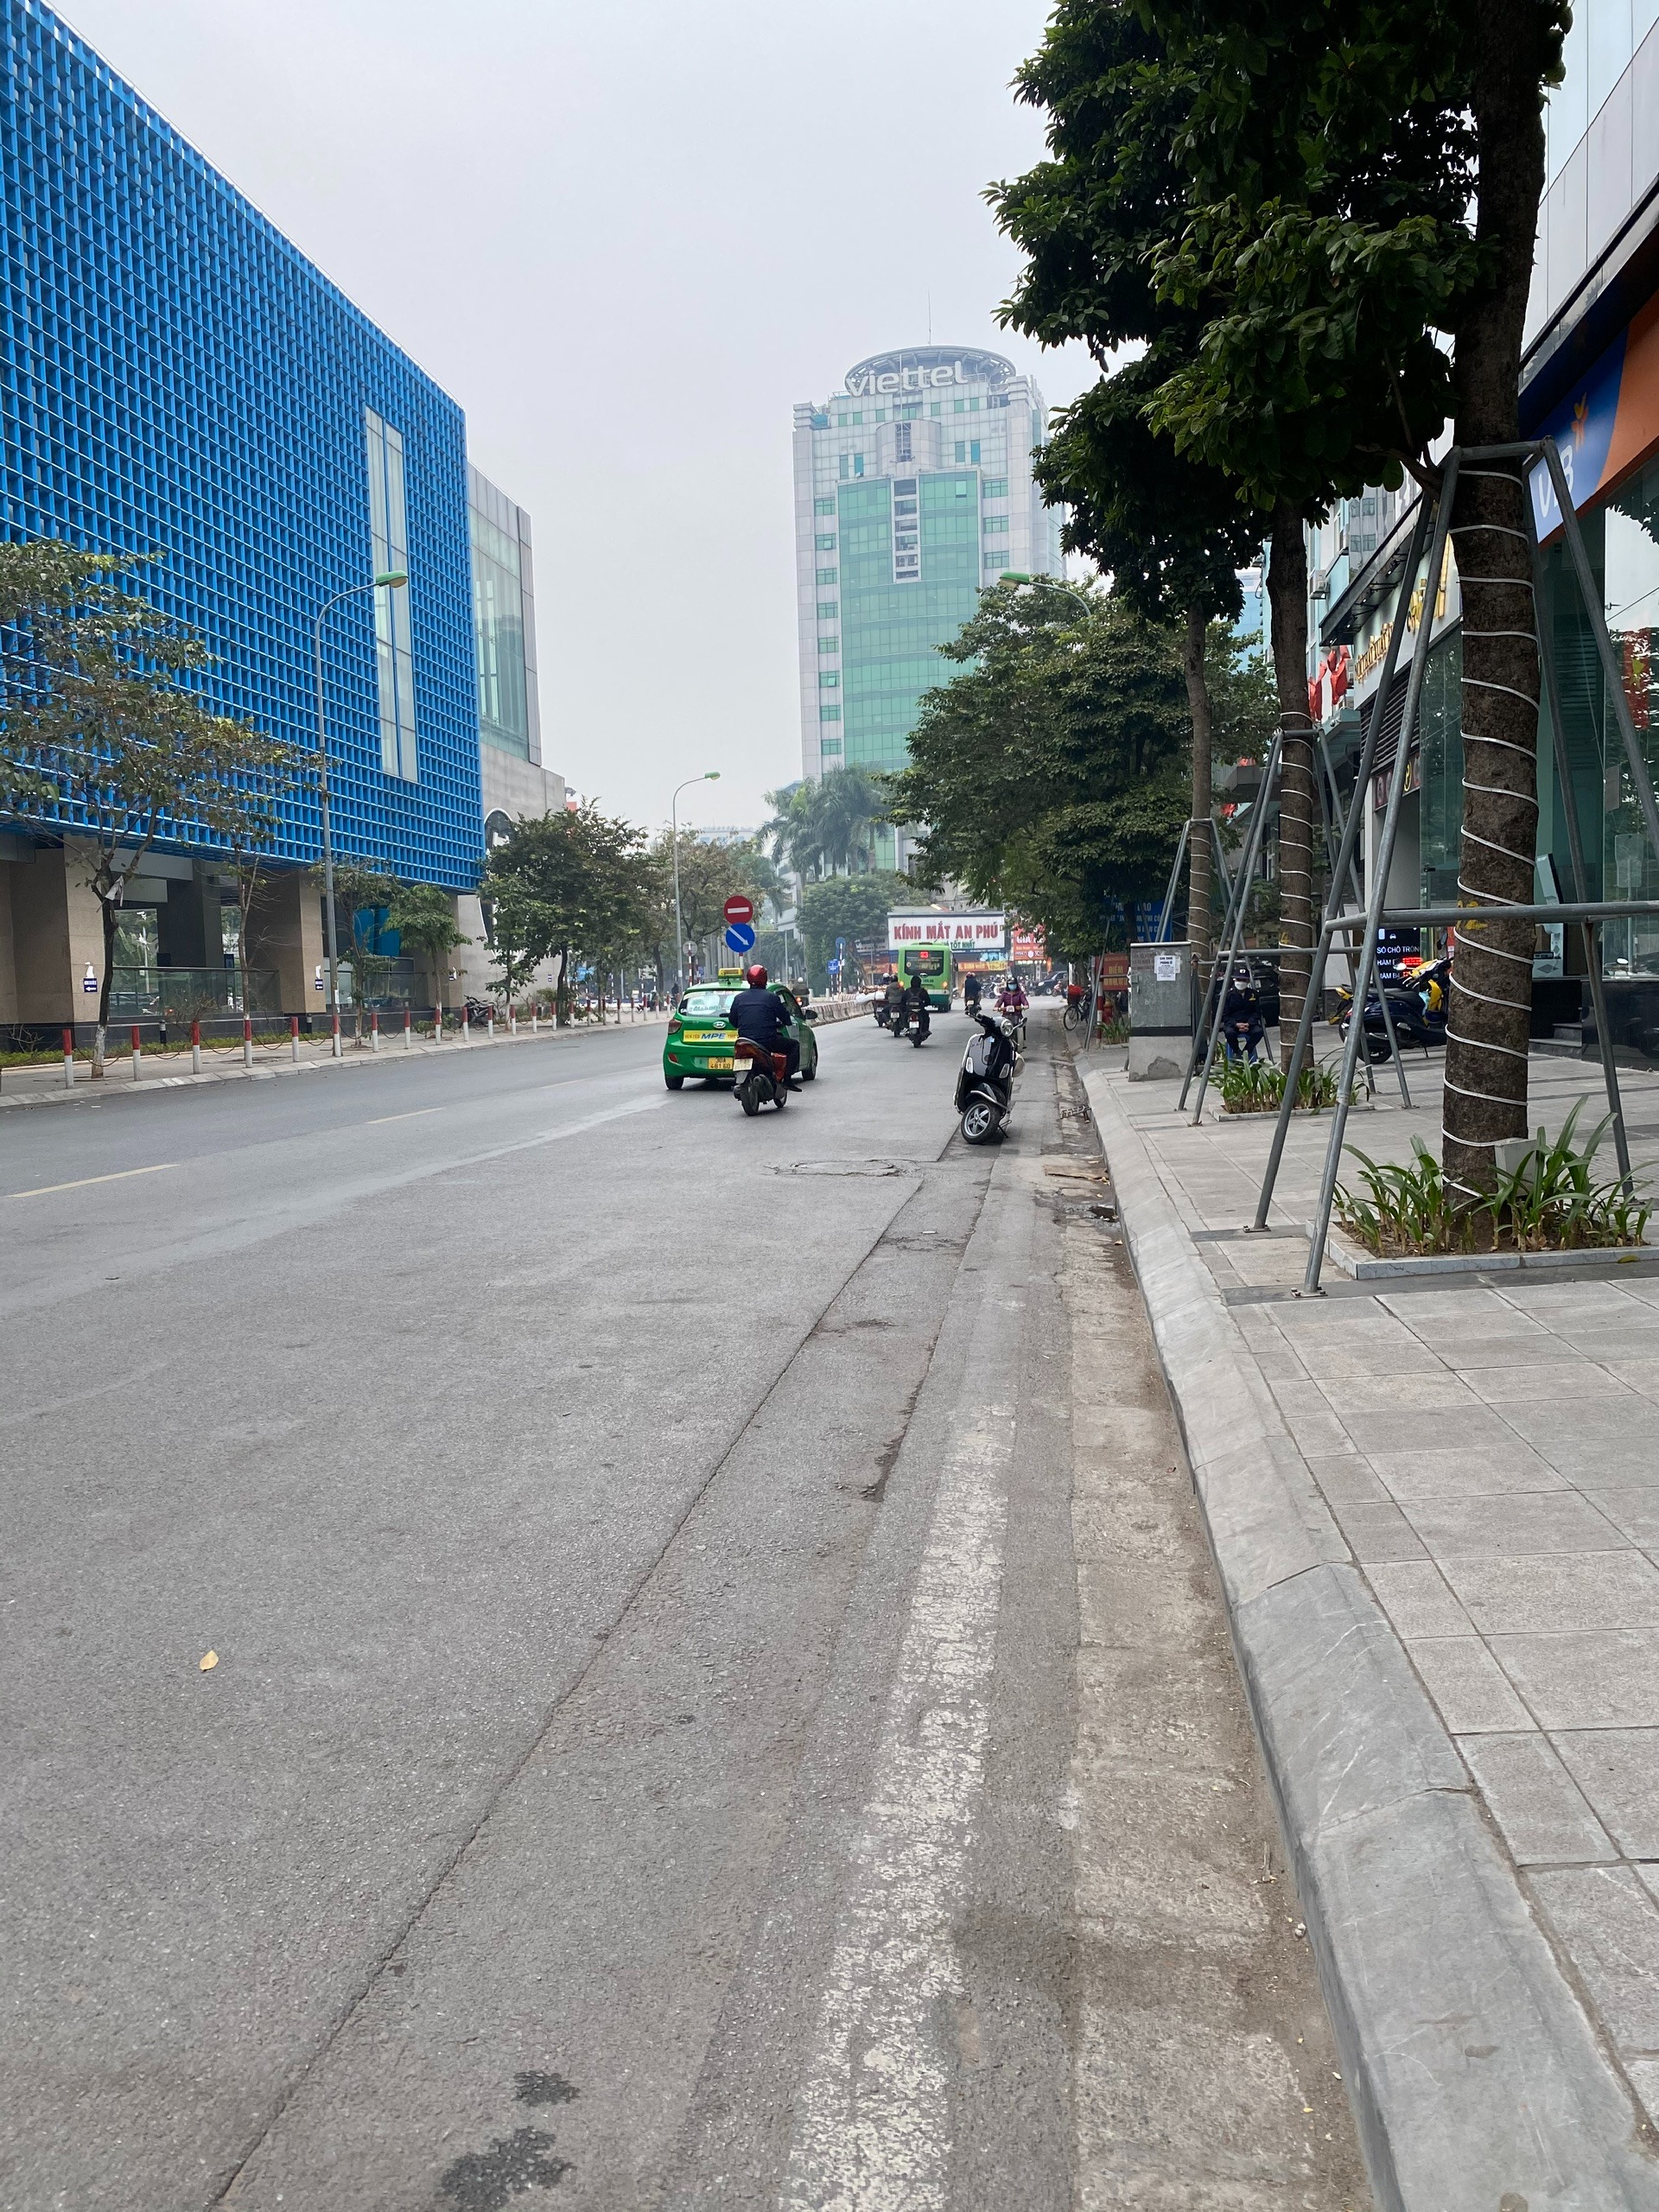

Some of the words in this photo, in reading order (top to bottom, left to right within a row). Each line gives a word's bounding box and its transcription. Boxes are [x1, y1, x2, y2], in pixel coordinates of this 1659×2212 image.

[846, 360, 968, 397] viettel
[1538, 444, 1574, 518] VB
[893, 923, 922, 940] KÍNH
[926, 920, 950, 939] MẮT
[956, 925, 972, 939] AN
[976, 921, 999, 939] PHÚ
